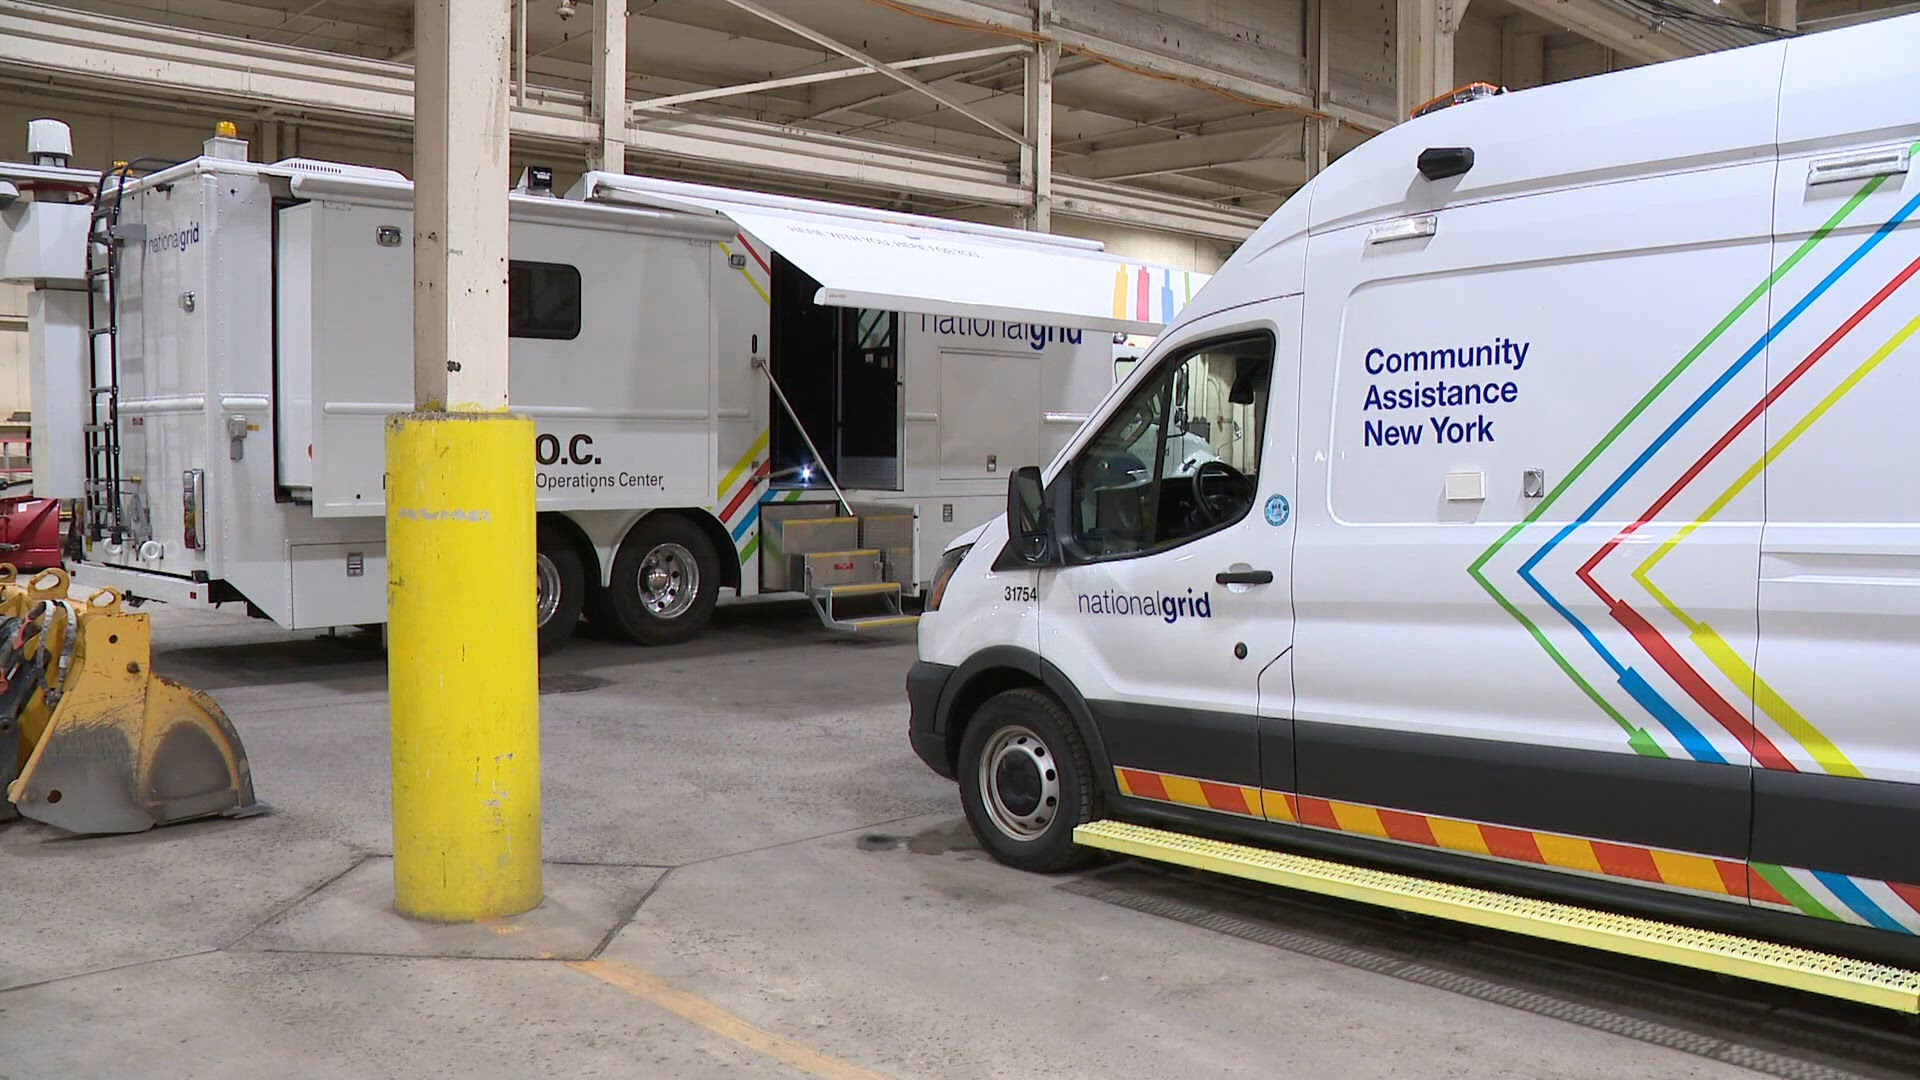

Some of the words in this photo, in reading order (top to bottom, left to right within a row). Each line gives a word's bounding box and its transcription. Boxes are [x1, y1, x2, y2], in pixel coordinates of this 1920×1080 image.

[148, 220, 199, 254] nationalgrid
[787, 225, 827, 238] HERE
[826, 231, 862, 242] WITH
[893, 240, 929, 252] HERE
[928, 245, 956, 255] FOR
[1364, 337, 1530, 375] Community
[1363, 380, 1518, 411] Assistance
[1364, 419, 1423, 447] New
[1429, 415, 1495, 444] York
[536, 472, 615, 491] Operations
[618, 471, 663, 487] Center
[1004, 585, 1037, 602] 31754
[1077, 587, 1212, 624] nationalgrid
